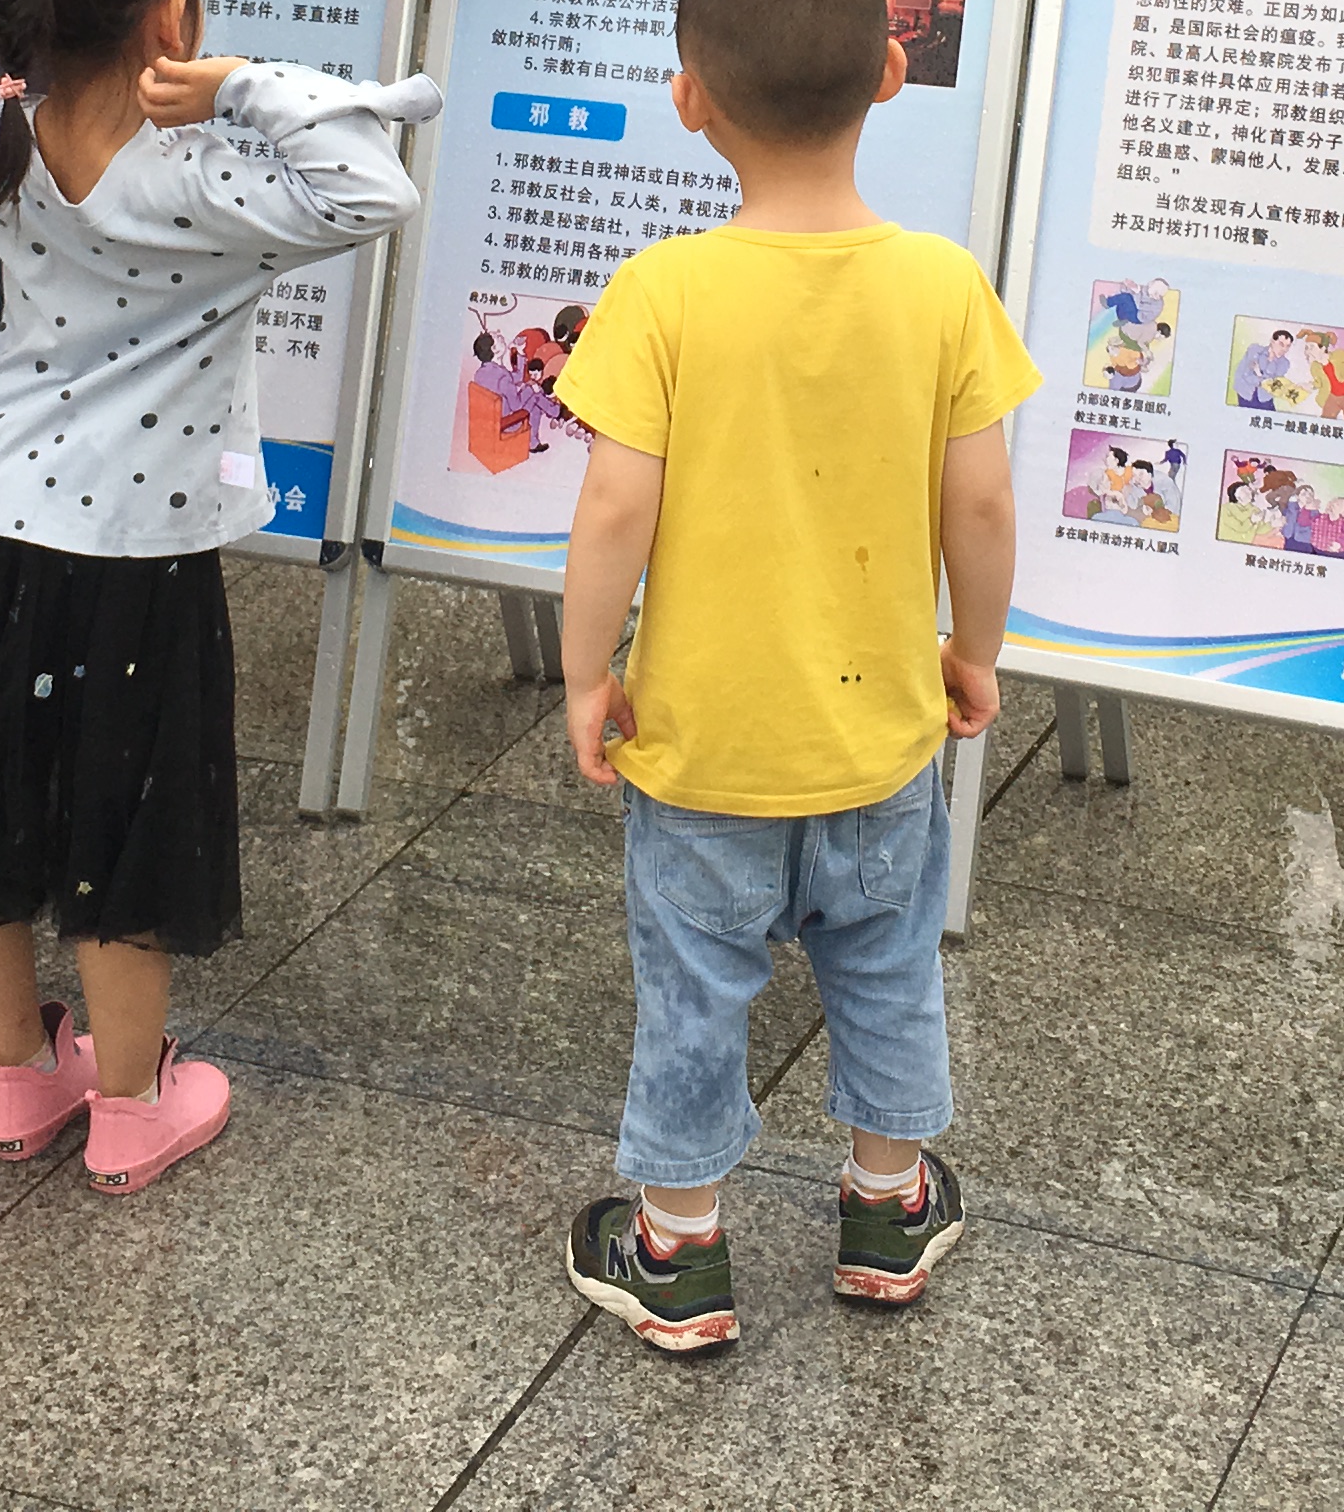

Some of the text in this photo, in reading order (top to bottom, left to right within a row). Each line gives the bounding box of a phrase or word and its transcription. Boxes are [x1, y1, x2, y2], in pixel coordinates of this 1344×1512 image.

[527, 101, 591, 132] 邪教
[1110, 210, 1279, 250] 并及时拨打110报警。
[1073, 409, 1142, 432] 教主至高无上
[1244, 552, 1328, 580] 聚会时行为反常
[606, 1234, 632, 1282] N
